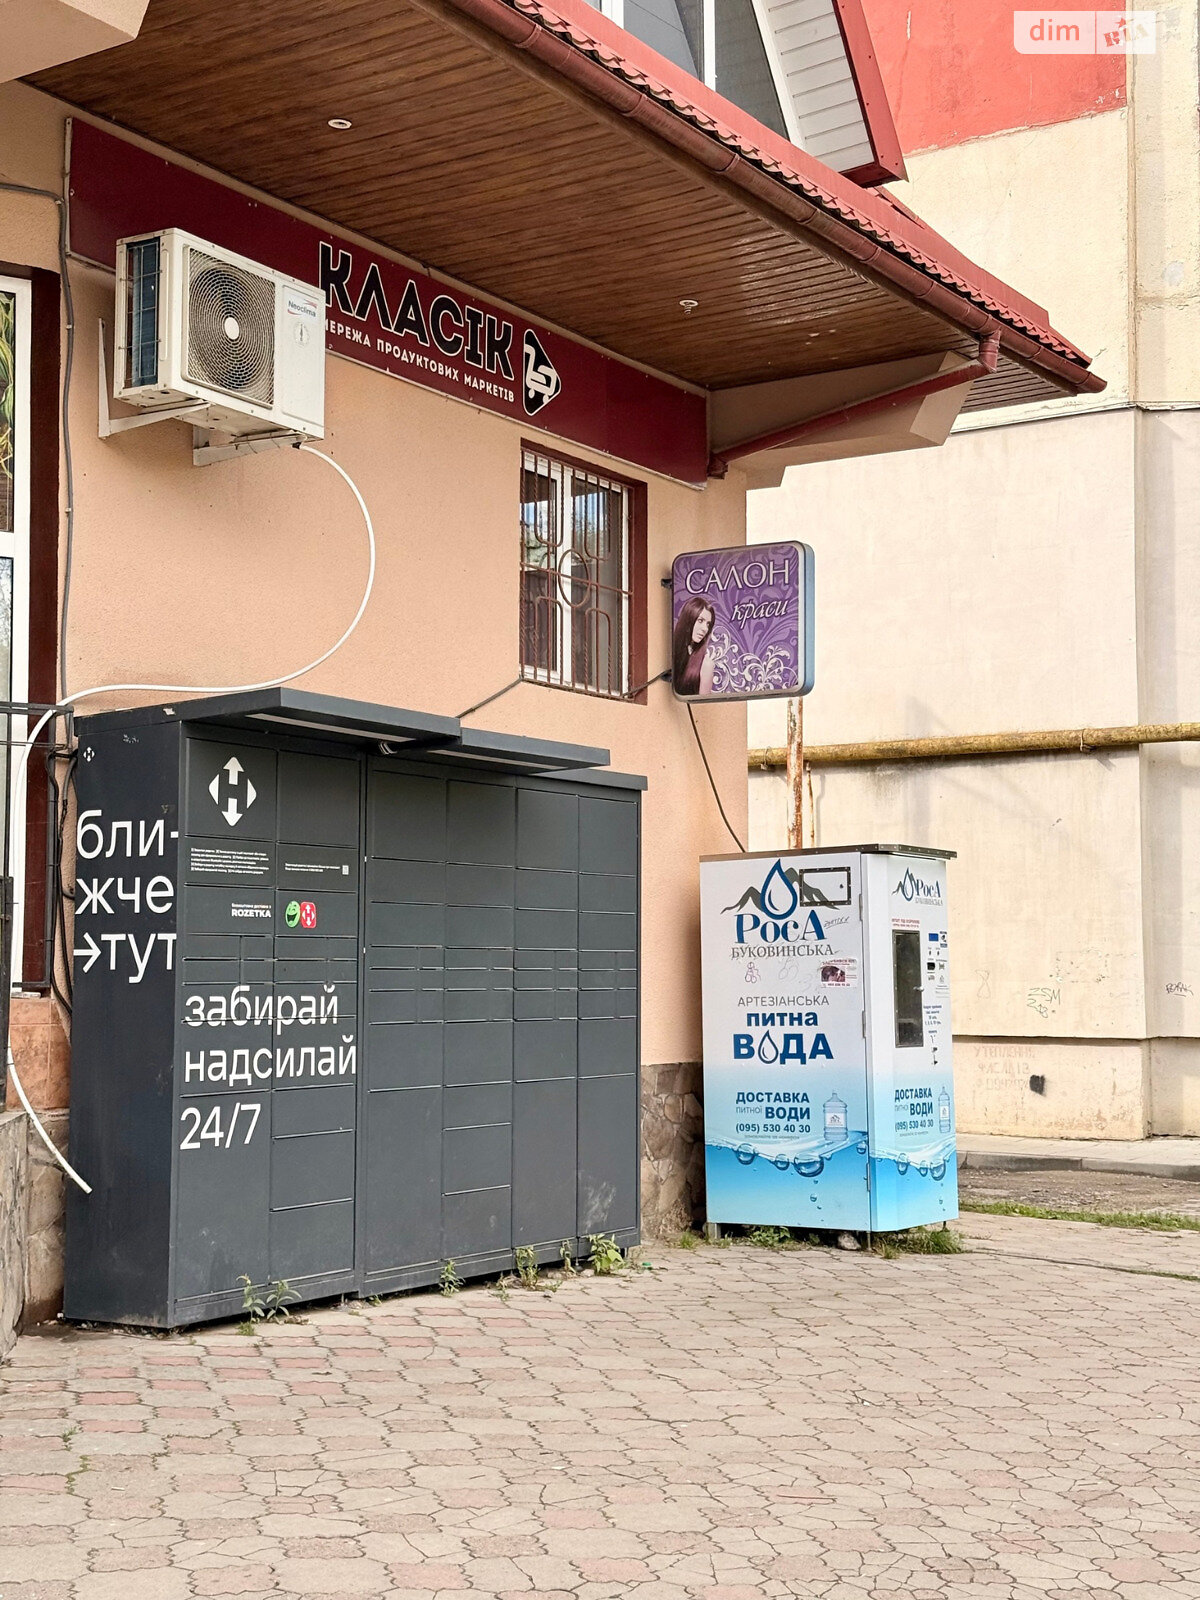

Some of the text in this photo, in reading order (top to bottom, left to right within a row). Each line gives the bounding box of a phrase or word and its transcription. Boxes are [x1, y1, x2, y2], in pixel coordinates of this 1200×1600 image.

[288, 300, 317, 318] Neoclima
[318, 240, 515, 381] КЛАСІК
[377, 338, 459, 382] ПРОДУКТОВИХ
[464, 362, 515, 403] МАРКЕТІВ
[685, 558, 790, 595] САЛОН
[731, 599, 789, 630] краси
[76, 809, 178, 859] бли-
[74, 874, 174, 915] жче
[231, 908, 272, 918] ROZETKA
[100, 932, 177, 983] тут
[731, 943, 835, 959] БУКОВИНСЬКА
[185, 983, 339, 1035] забирай
[737, 994, 830, 1008] АРТЕЗІАНСЬКА
[747, 1011, 818, 1027] питна
[185, 1034, 356, 1087] надсилай
[735, 1091, 810, 1105] ДОСТАВКА
[894, 1088, 933, 1102] ДОСТАВКА
[765, 1106, 811, 1122] ВОДИ
[909, 1102, 934, 1117] ВОДИ
[179, 1102, 262, 1150] 24/7
[735, 1123, 811, 1134] (095) 530 40 30
[894, 1118, 935, 1132] (095) 530 40 30
